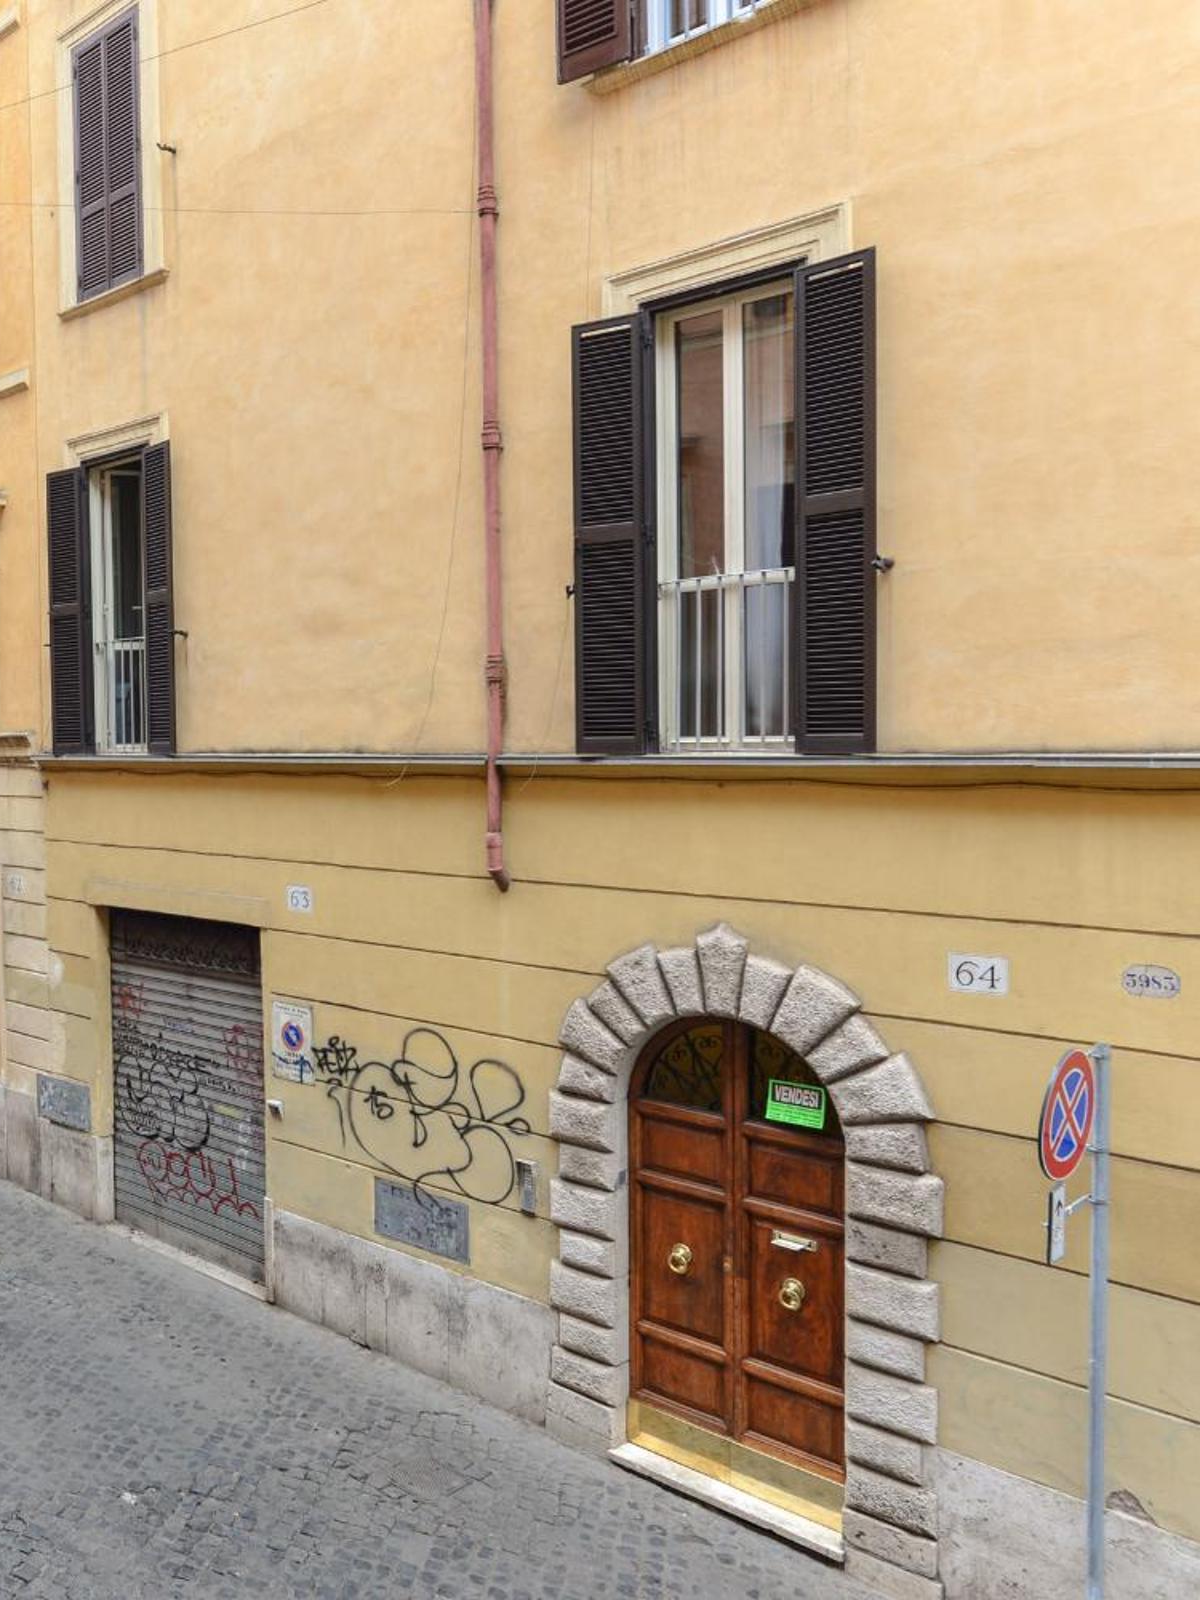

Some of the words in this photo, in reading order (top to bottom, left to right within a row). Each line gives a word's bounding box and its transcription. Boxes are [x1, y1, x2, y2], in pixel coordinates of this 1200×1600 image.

[290, 889, 310, 909] 63
[955, 960, 1002, 990] 64
[774, 1084, 819, 1109] VENDESI
